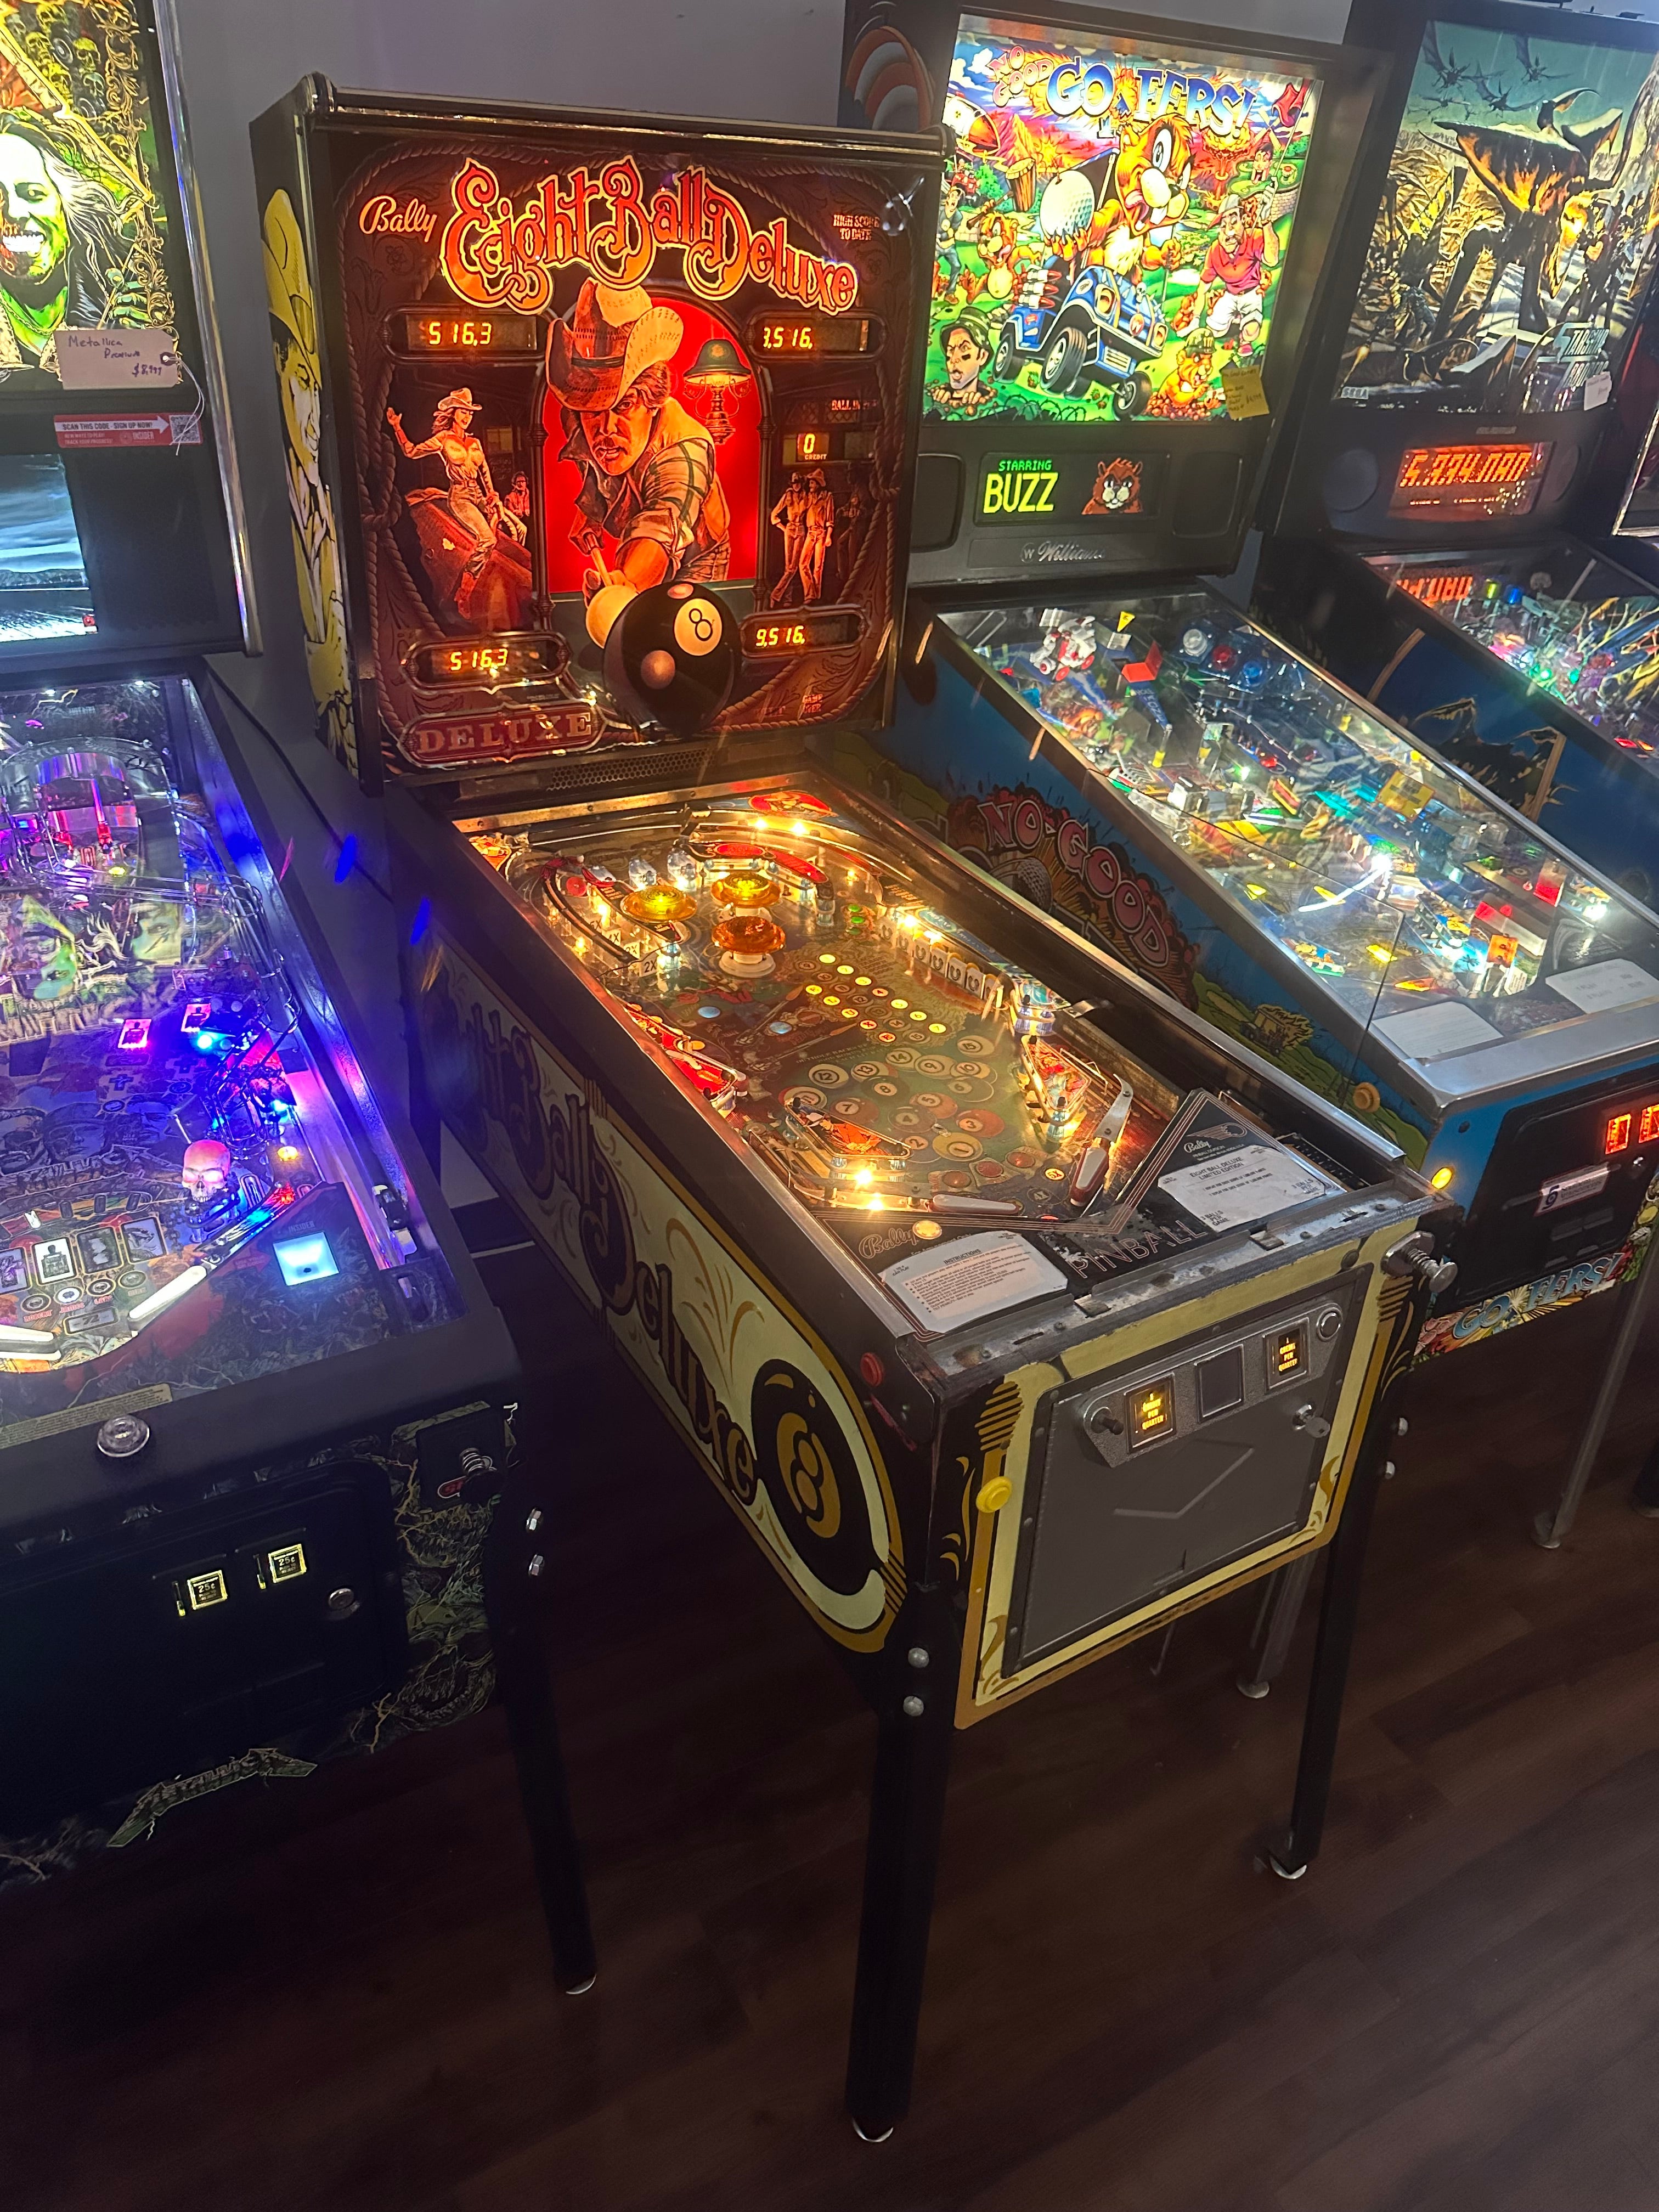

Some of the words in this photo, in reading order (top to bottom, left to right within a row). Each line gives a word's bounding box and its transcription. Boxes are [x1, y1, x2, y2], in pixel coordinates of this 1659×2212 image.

[988, 46, 1025, 81] NO
[993, 57, 1054, 108] GOOD
[359, 195, 438, 242] Bally
[833, 215, 853, 227] HIGH
[854, 216, 880, 228] SCORE
[439, 157, 601, 315] Eight
[588, 155, 706, 291] Ball
[683, 177, 859, 316] Deluxe
[840, 228, 851, 240] TO
[851, 228, 871, 240] DATE
[68, 335, 122, 347] Metallica
[1341, 386, 1369, 399] SEGA
[832, 400, 851, 410] BALL
[998, 459, 1052, 471] STARRING
[983, 472, 1059, 514] BUZZ
[1039, 540, 1105, 562] Williams
[689, 608, 713, 641] 8
[417, 713, 591, 754] DELUXE
[977, 799, 1042, 851] NO
[1057, 819, 1169, 968] GOOD
[644, 959, 657, 973] 2X
[962, 1042, 977, 1051] 15
[892, 1052, 907, 1063] 14
[857, 1065, 873, 1076] 13
[960, 1064, 975, 1073] 10
[818, 1072, 834, 1082] 12
[1183, 1139, 1212, 1153] Bally
[1190, 1169, 1208, 1178] EIGHT
[1207, 1163, 1222, 1172] BALL
[1220, 1156, 1244, 1167] DELUXE
[1198, 1170, 1222, 1180] LIMITED
[1221, 1163, 1244, 1173] EDITION
[1048, 1170, 1063, 1179] 5X
[1296, 1178, 1313, 1188] BALLS
[1301, 1183, 1313, 1192] PER
[1205, 1210, 1223, 1220] BALLS
[1212, 1217, 1230, 1226] GAME
[287, 1220, 315, 1233] INSIDER
[859, 1227, 917, 1259] Bally
[1066, 1220, 1207, 1278] PINBALL
[943, 1249, 982, 1264] INSTRUCTIONS
[579, 1113, 757, 1506] Deluxe
[1279, 1343, 1296, 1355] CREDIT
[1284, 1353, 1294, 1361] PER
[1278, 1358, 1298, 1372] QUARTER
[1142, 1398, 1161, 1413] CREDIT
[1148, 1408, 1159, 1419] PER
[1142, 1415, 1164, 1430] QUARTER
[278, 1556, 296, 1566] 25¢
[198, 1583, 215, 1593] 25¢
